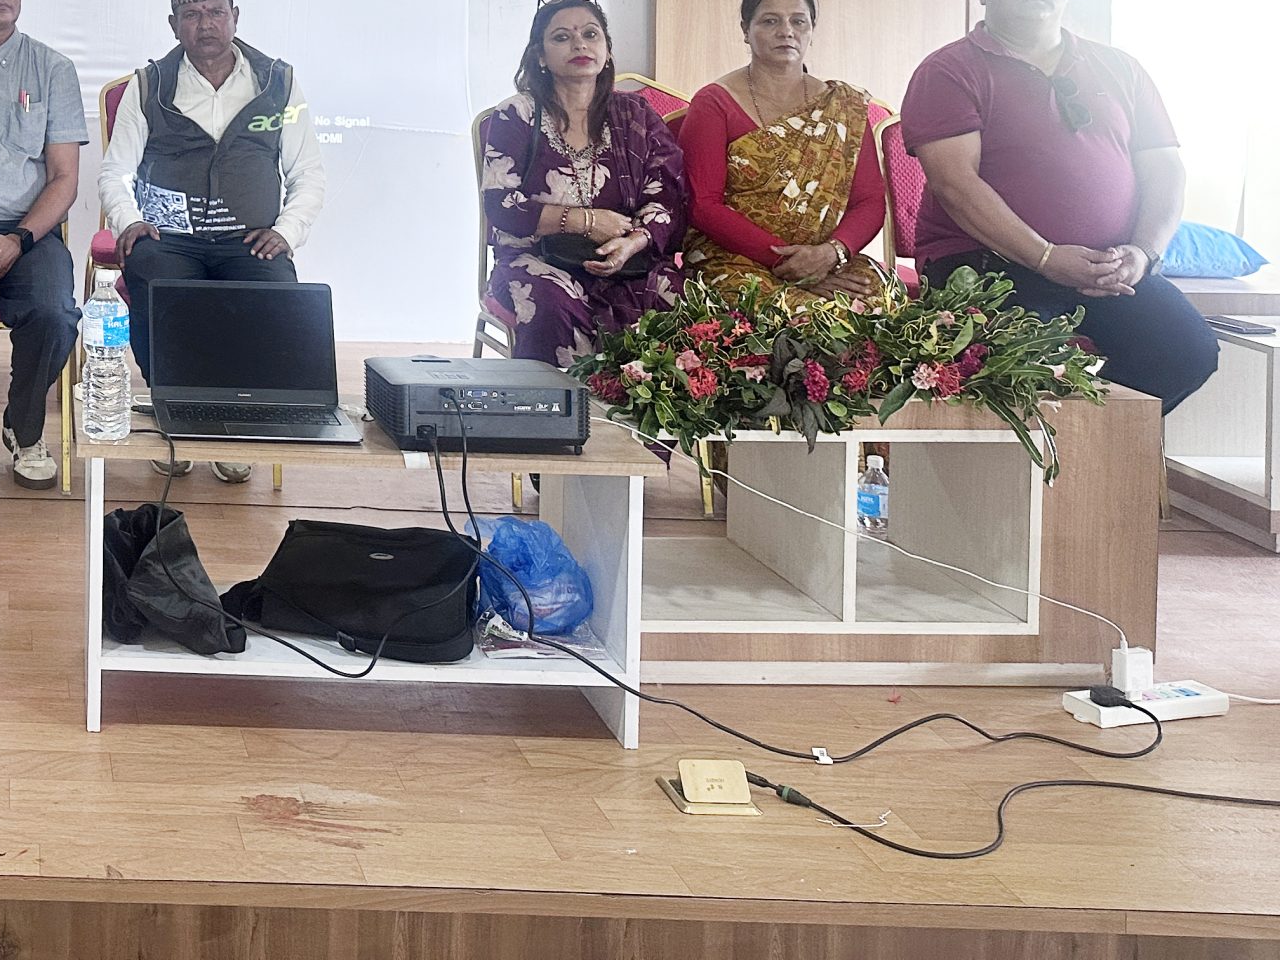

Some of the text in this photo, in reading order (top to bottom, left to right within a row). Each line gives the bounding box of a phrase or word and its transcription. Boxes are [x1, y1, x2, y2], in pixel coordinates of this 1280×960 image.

[248, 103, 308, 132] acer
[315, 116, 370, 128] No Signal
